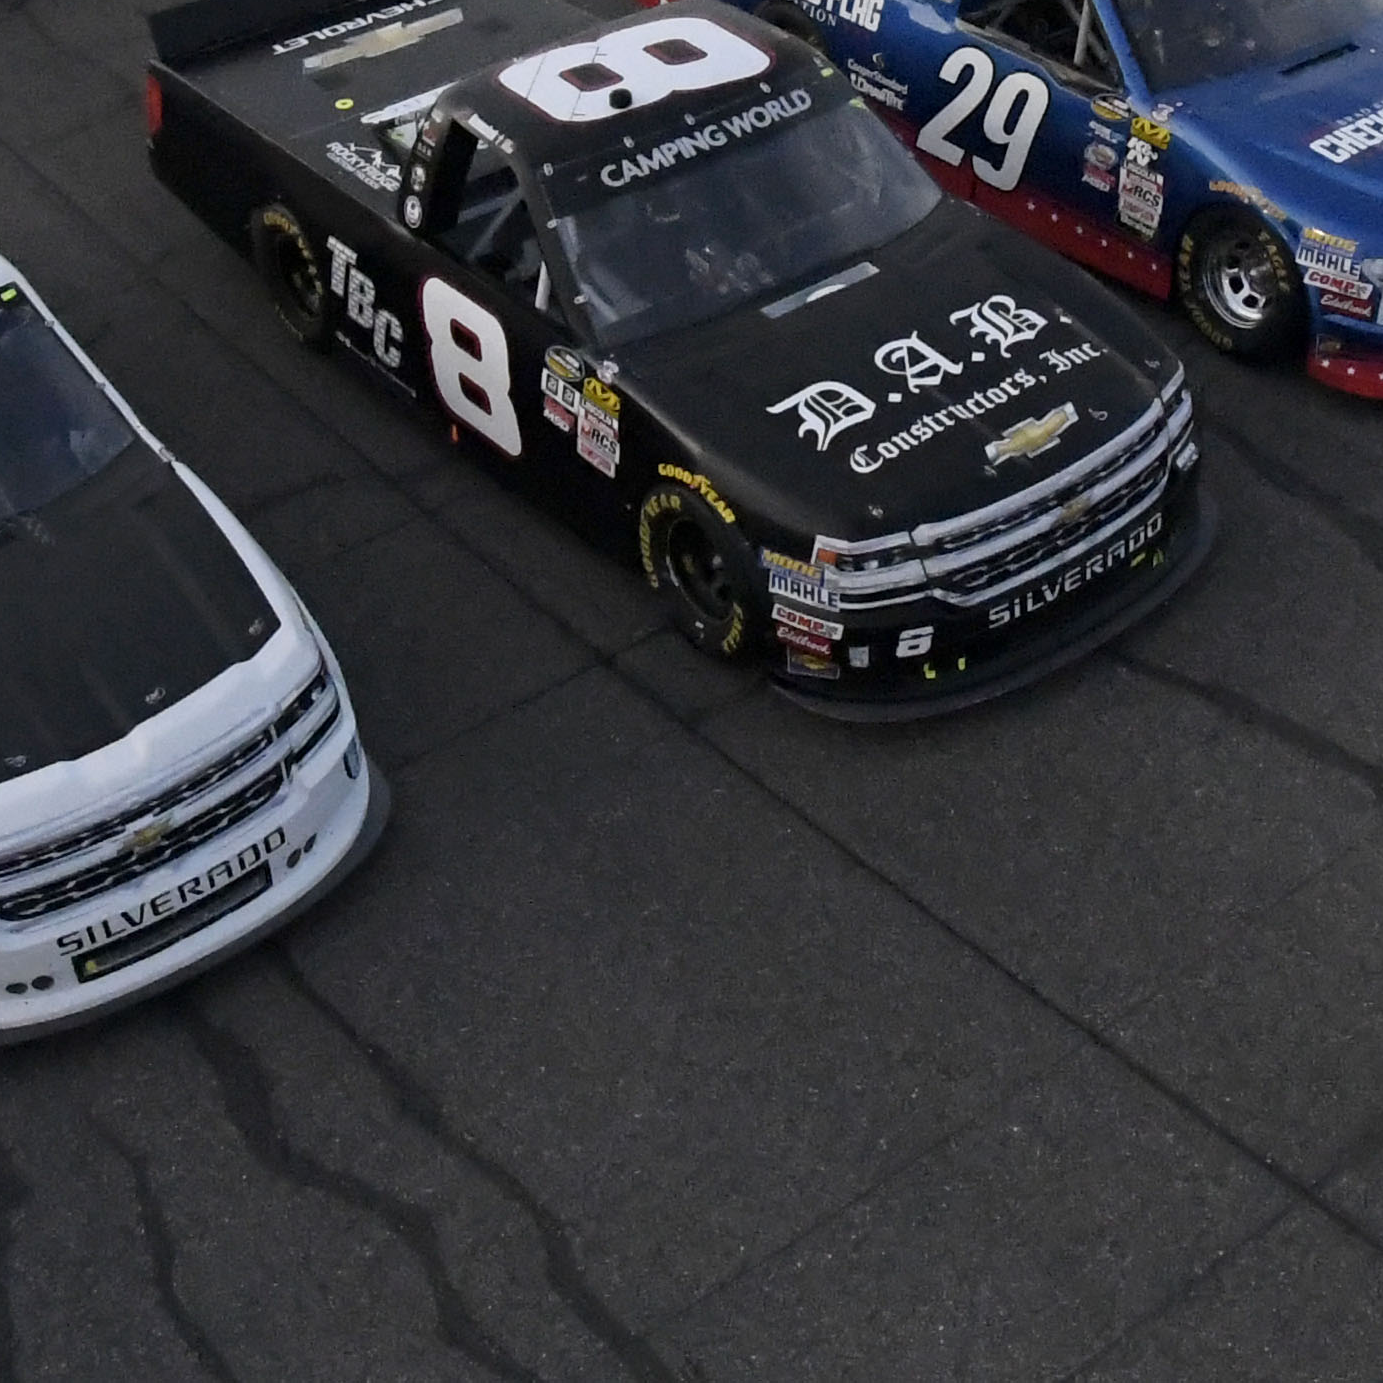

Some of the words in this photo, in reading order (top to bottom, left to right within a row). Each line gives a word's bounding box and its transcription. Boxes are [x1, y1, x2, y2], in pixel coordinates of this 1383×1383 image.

[497, 17, 772, 122] 8
[916, 46, 1050, 192] 29
[600, 128, 727, 187] CAMPING
[723, 87, 812, 139] WORLD
[326, 235, 404, 369] TBC
[1297, 247, 1360, 278] MAHLE
[422, 276, 522, 457] 8
[850, 367, 1048, 473] Constructors,
[1039, 341, 1108, 374] Inc.
[658, 463, 736, 524] GOODYEAR
[771, 573, 839, 609] MAHLE
[988, 511, 1163, 630] SILVERADO
[56, 826, 287, 957] SILVERADO
